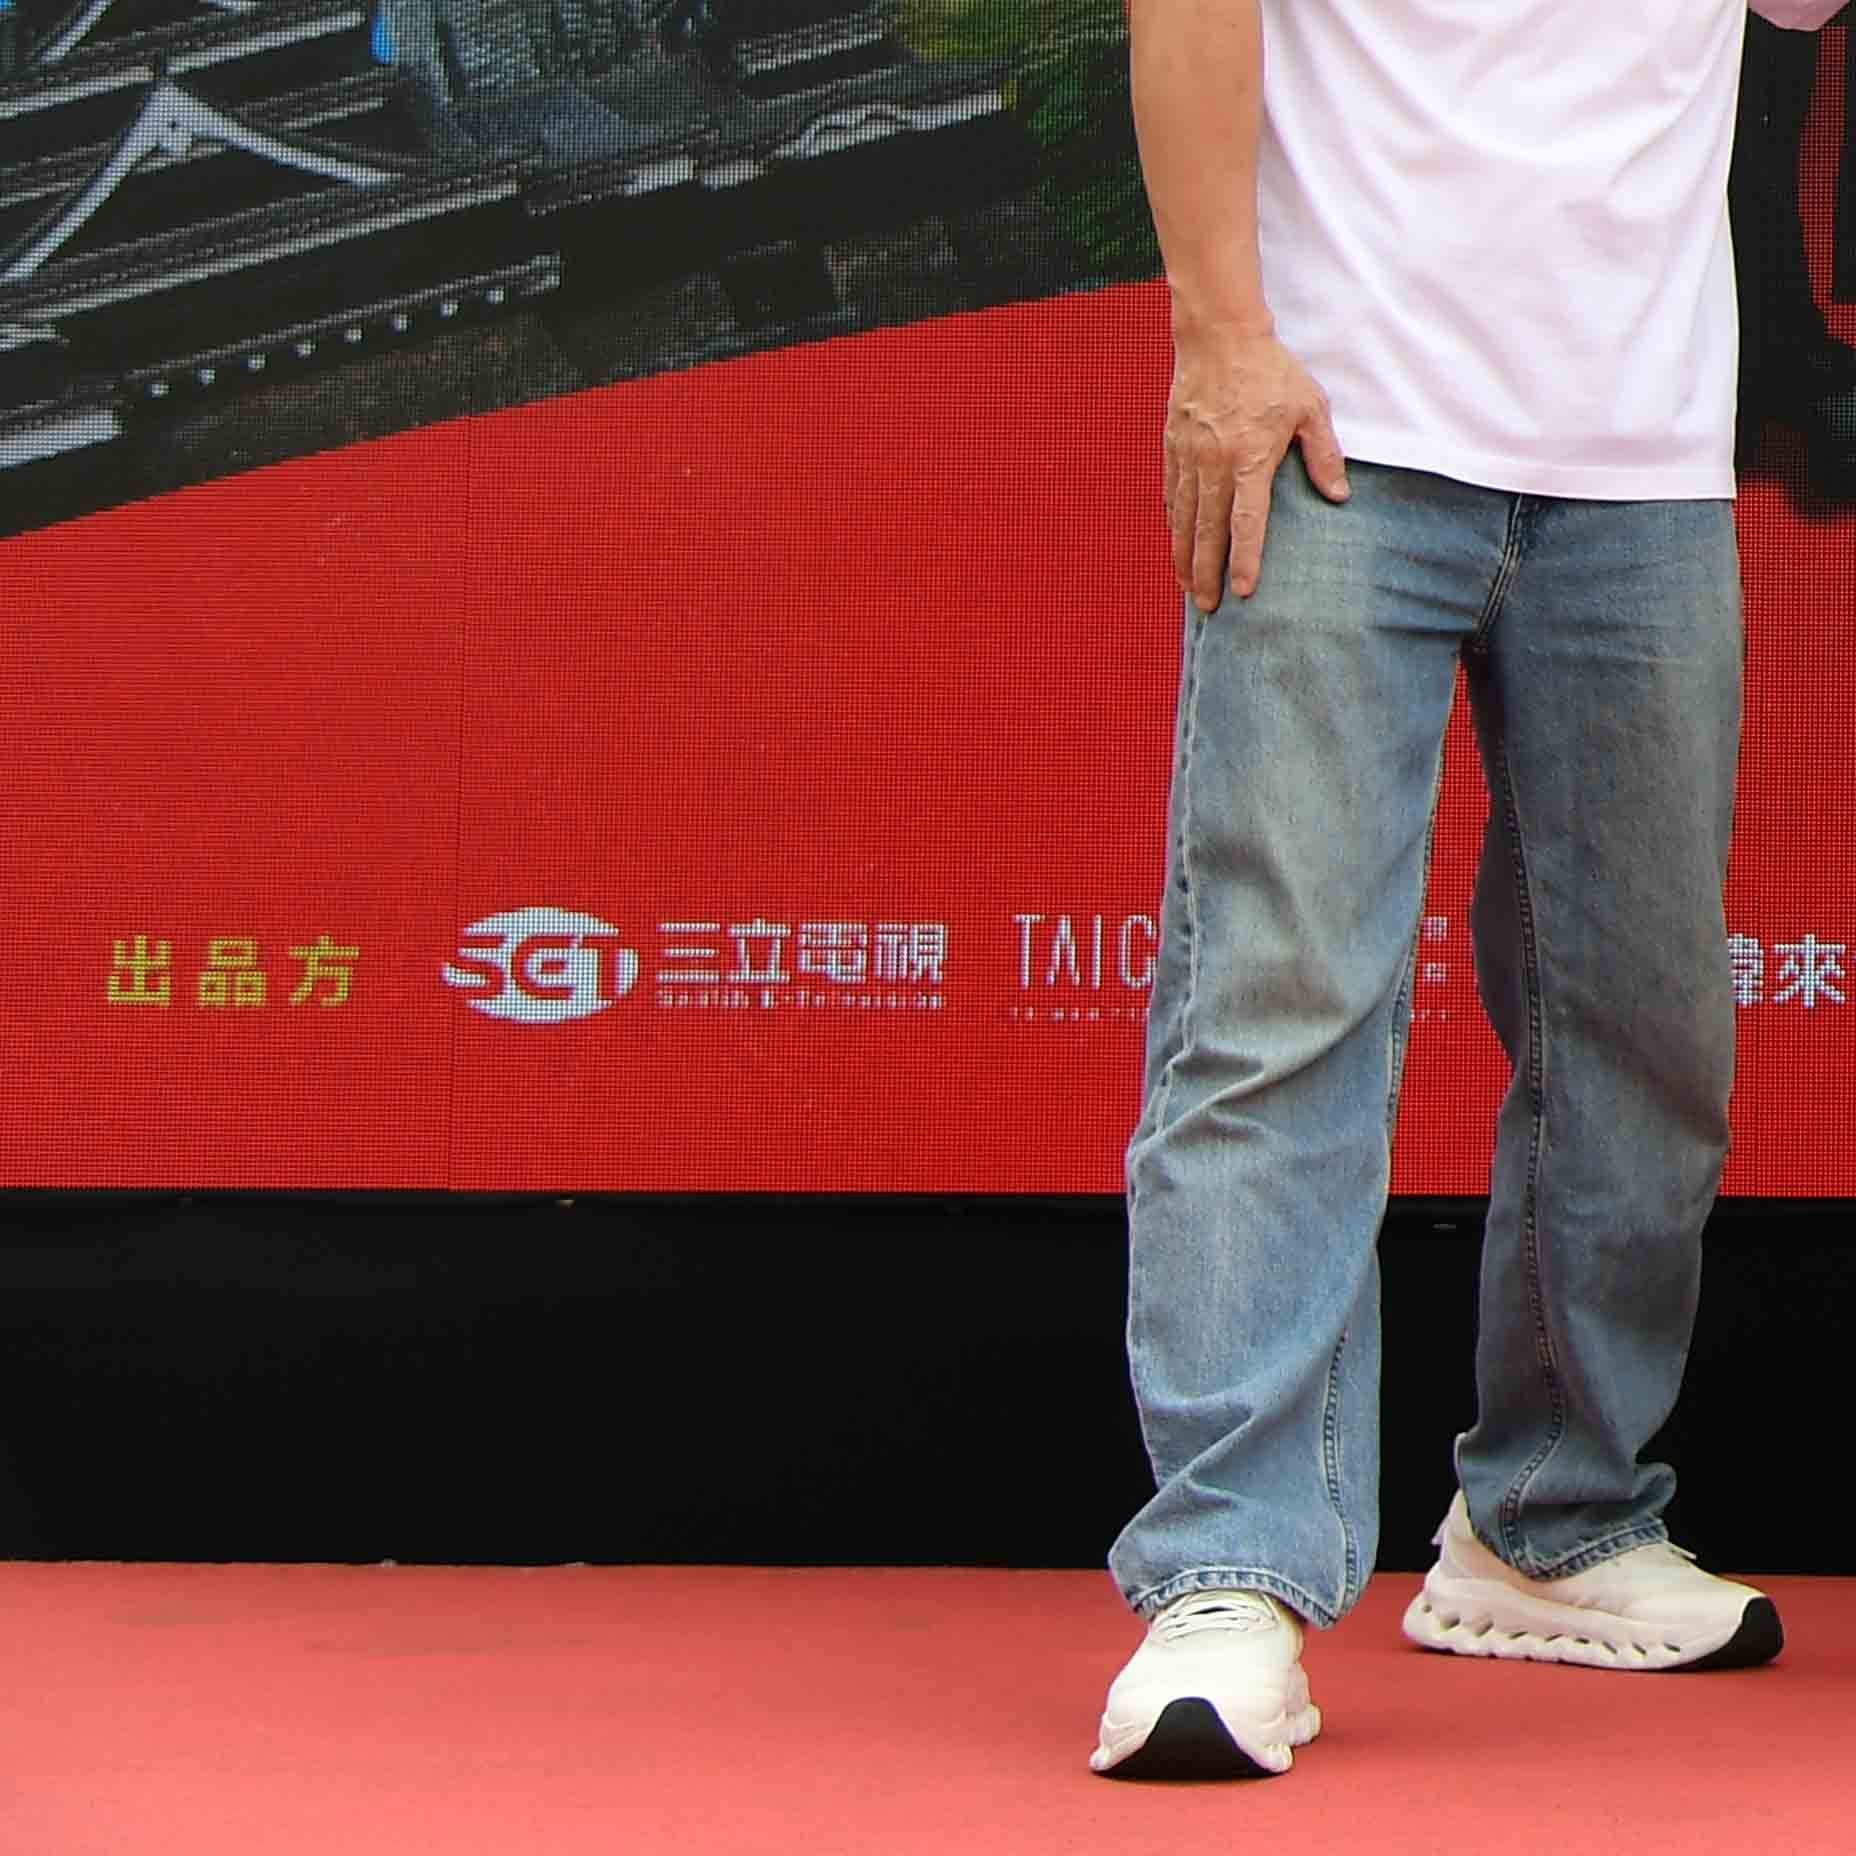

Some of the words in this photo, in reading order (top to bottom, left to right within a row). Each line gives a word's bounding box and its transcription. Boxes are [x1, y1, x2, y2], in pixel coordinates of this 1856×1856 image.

[106, 934, 360, 1006] 出品方
[656, 918, 948, 983] 三立電視
